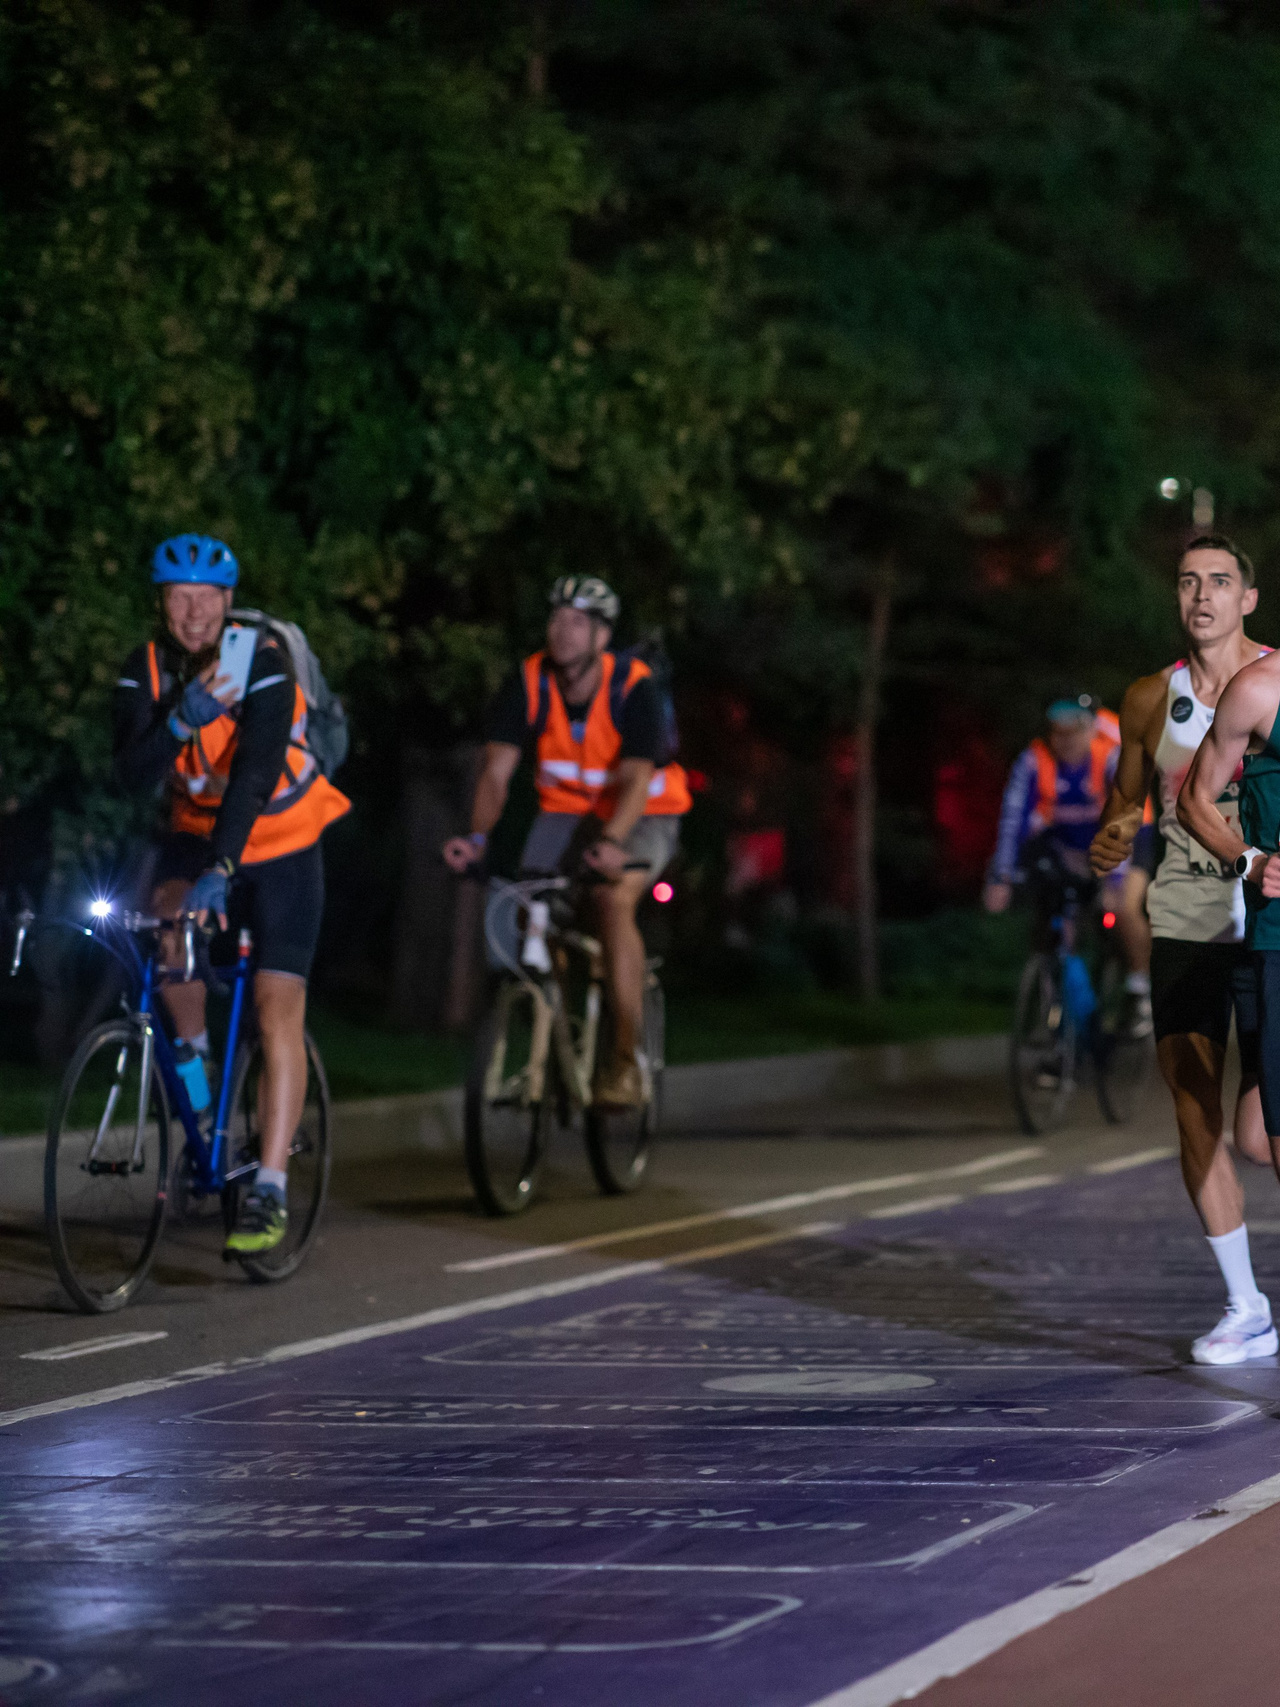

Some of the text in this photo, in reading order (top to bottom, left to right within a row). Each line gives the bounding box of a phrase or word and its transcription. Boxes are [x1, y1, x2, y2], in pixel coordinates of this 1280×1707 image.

[267, 1410, 473, 1420] ногу
[454, 1506, 755, 1519] пятку
[405, 1518, 868, 1532] чувствуя
